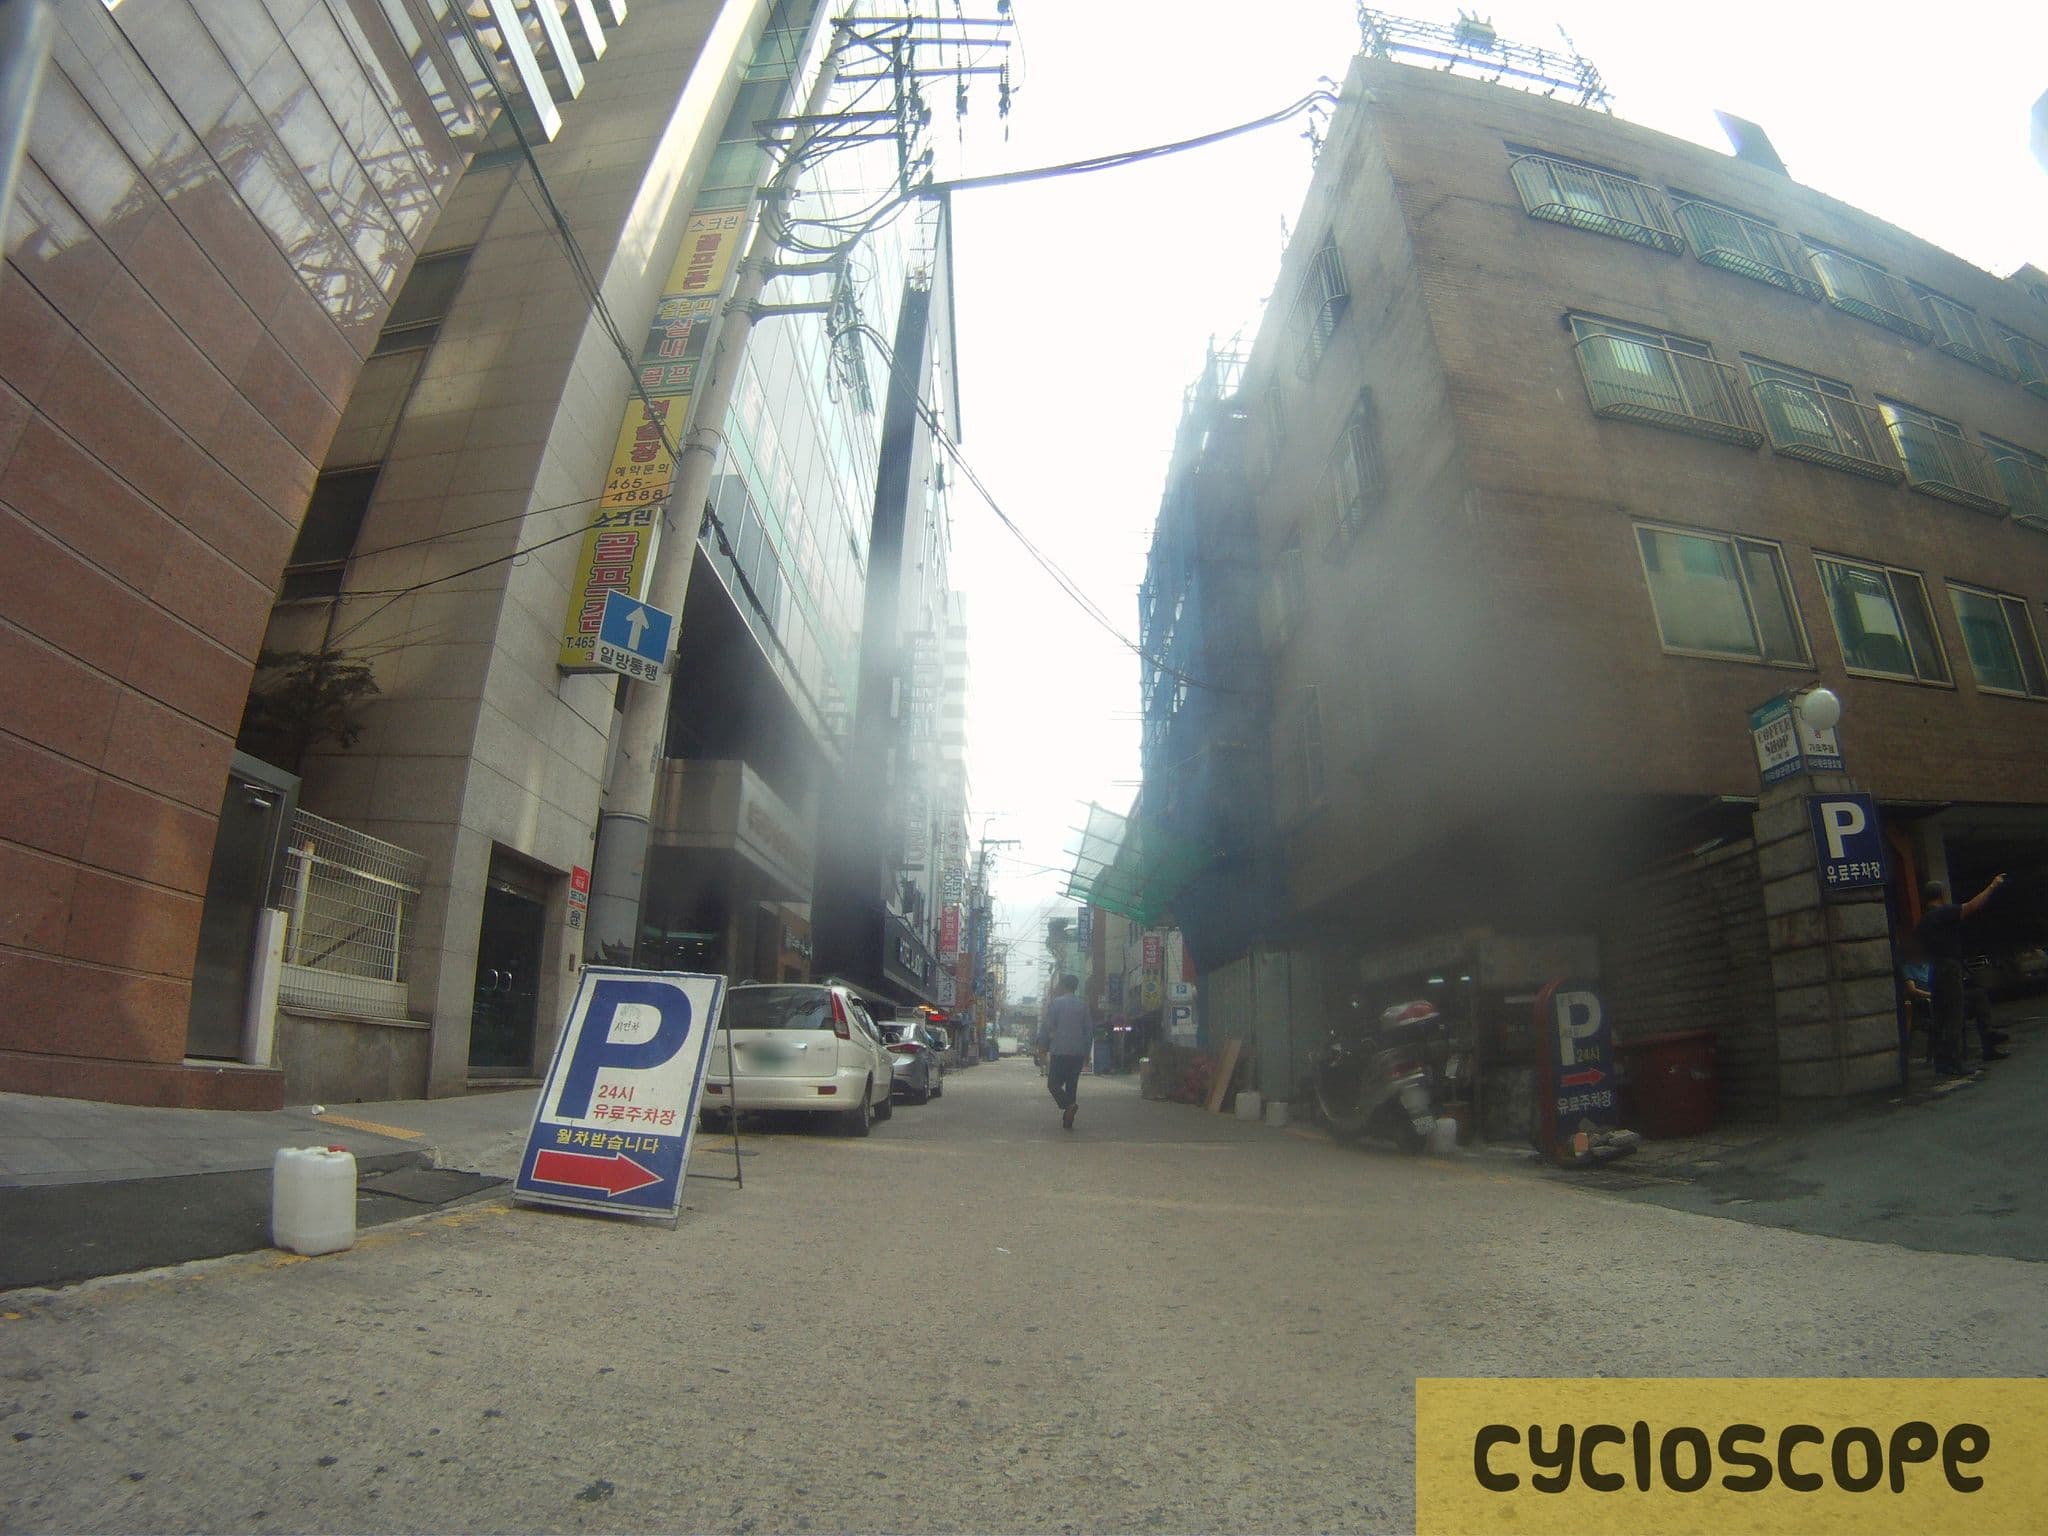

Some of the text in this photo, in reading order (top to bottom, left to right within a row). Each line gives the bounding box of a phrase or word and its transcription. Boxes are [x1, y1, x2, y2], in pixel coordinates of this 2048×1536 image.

[688, 216, 738, 232] 스크린
[659, 319, 693, 357] 실내
[641, 364, 692, 386] 골프
[616, 464, 669, 477] 예약문의
[609, 479, 651, 490] 465-
[612, 489, 663, 502] 4888
[594, 510, 651, 528] 스크린
[600, 646, 658, 682] 일방통행
[1821, 802, 1866, 858] P
[1826, 861, 1880, 883] 유료주차장
[1171, 1006, 1191, 1026] P
[1556, 991, 1601, 1066] P
[555, 980, 693, 1120] P
[598, 1084, 635, 1102] 24시
[1557, 1089, 1612, 1114] 유료주차장
[593, 1104, 677, 1126] 유료주차장
[556, 1128, 660, 1153] 월차받습니다
